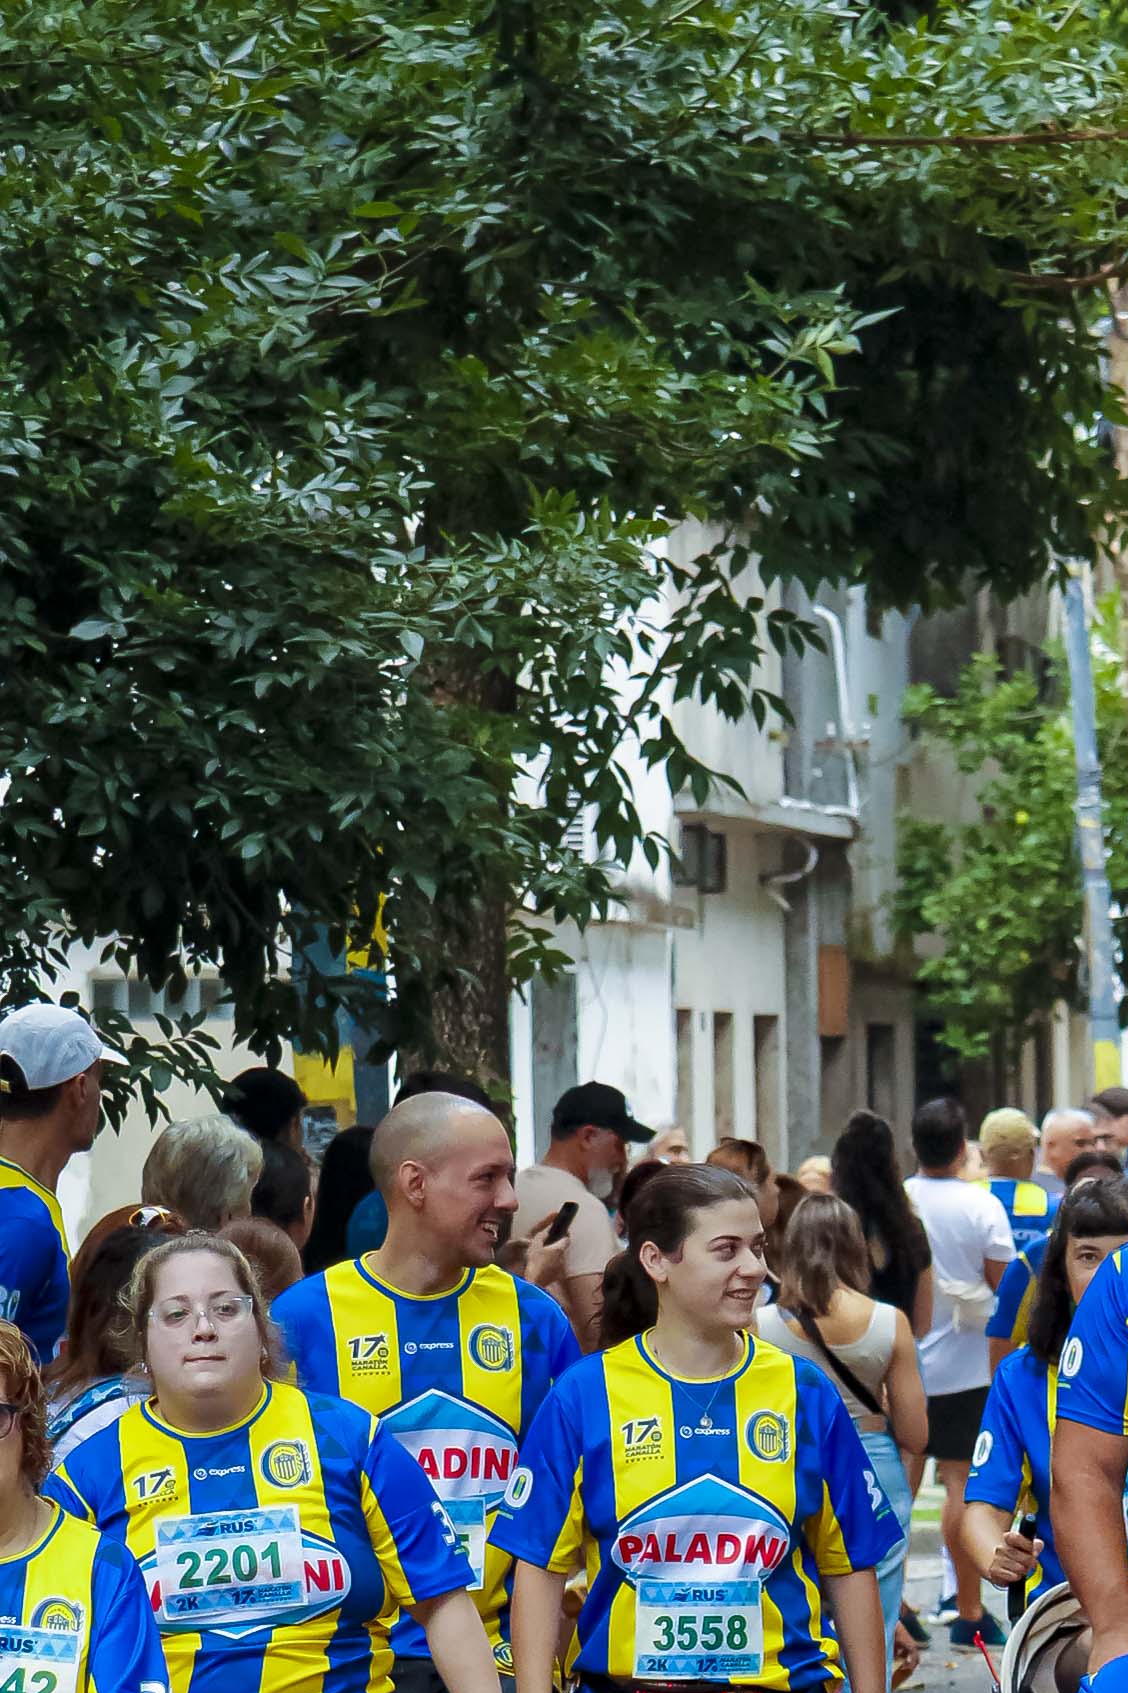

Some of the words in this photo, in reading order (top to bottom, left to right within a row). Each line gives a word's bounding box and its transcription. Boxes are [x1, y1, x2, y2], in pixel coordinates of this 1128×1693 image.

[419, 1342, 454, 1350] express
[694, 1427, 731, 1436] express
[209, 1465, 246, 1477] express
[220, 1519, 254, 1534] RUS
[618, 1532, 788, 1570] PALADINI
[176, 1541, 282, 1590] 2201
[692, 1589, 725, 1601] RUS
[176, 1596, 200, 1612] 2K
[653, 1614, 748, 1651] 3558
[647, 1659, 668, 1671] 2K
